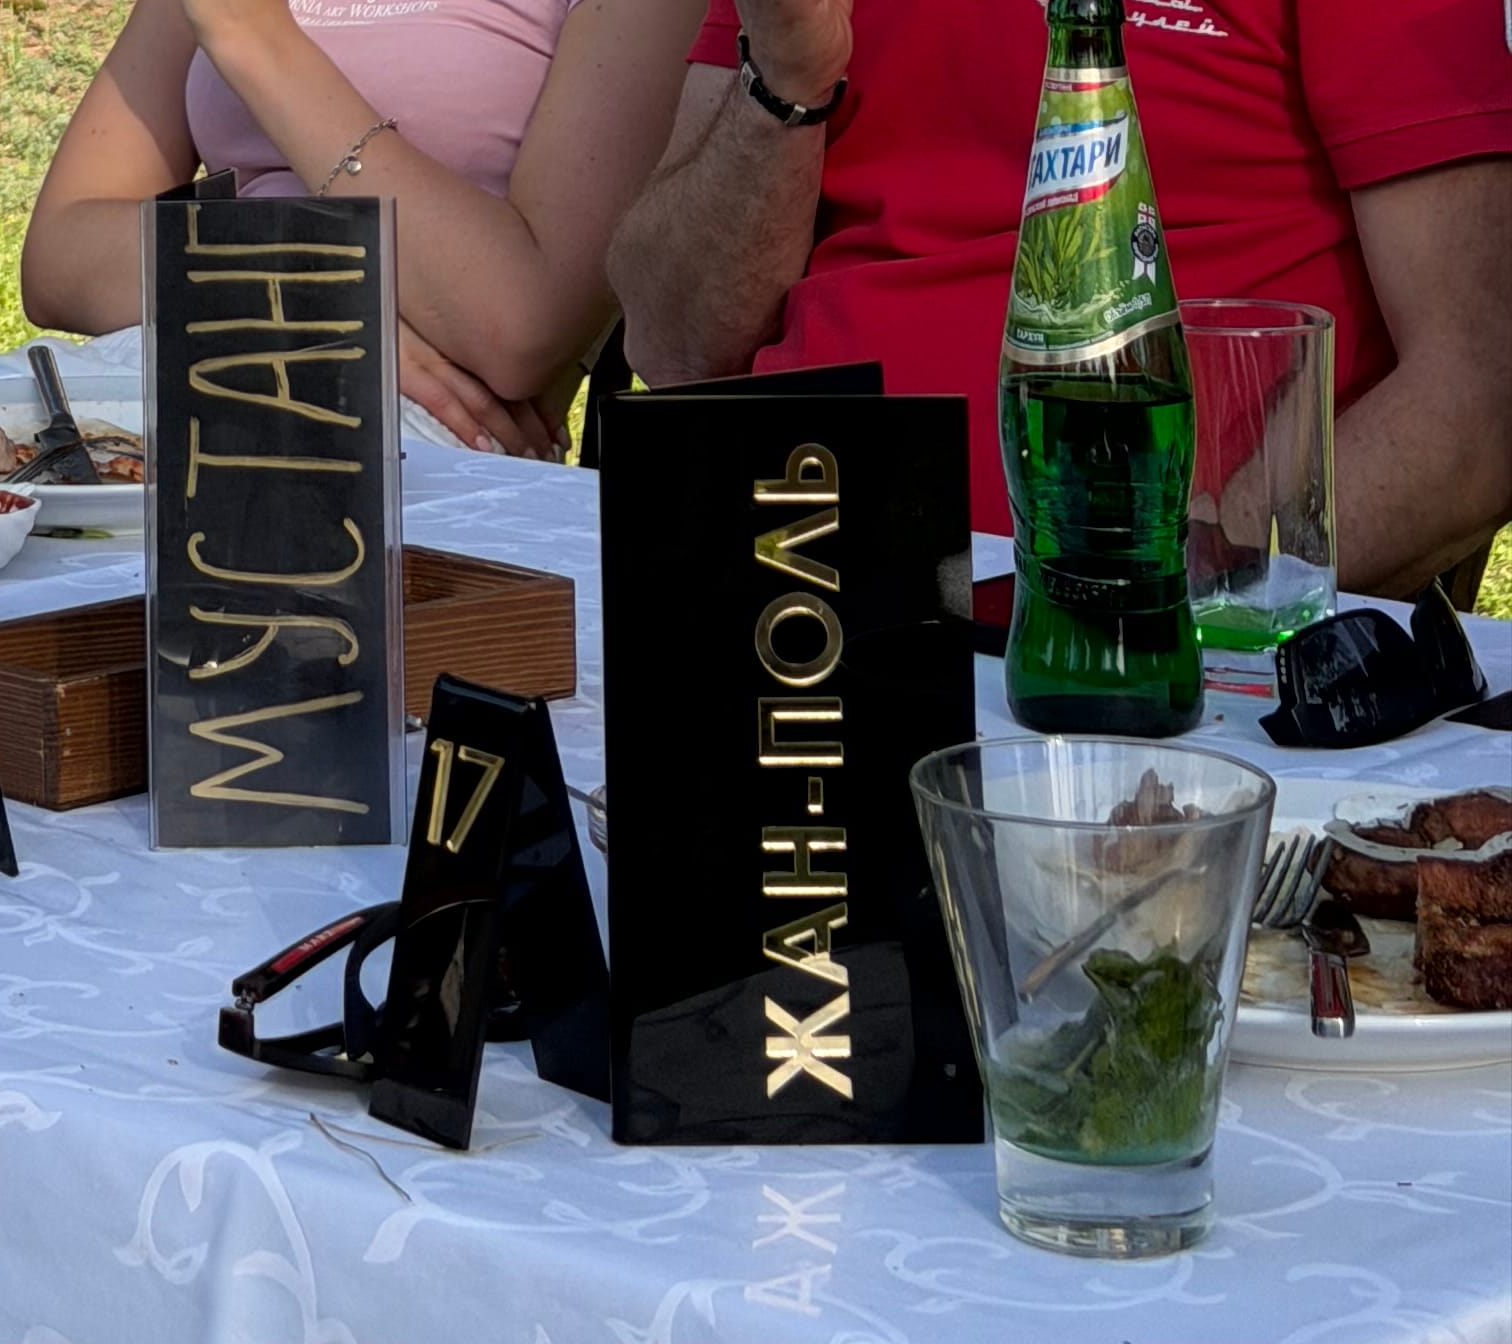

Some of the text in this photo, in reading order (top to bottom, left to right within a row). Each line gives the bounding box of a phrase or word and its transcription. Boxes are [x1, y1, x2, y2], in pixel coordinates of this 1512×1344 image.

[186, 204, 370, 814] МУСТАНГ
[427, 738, 505, 854] 17
[754, 443, 854, 1101] ЖАН-ПОЛЬ
